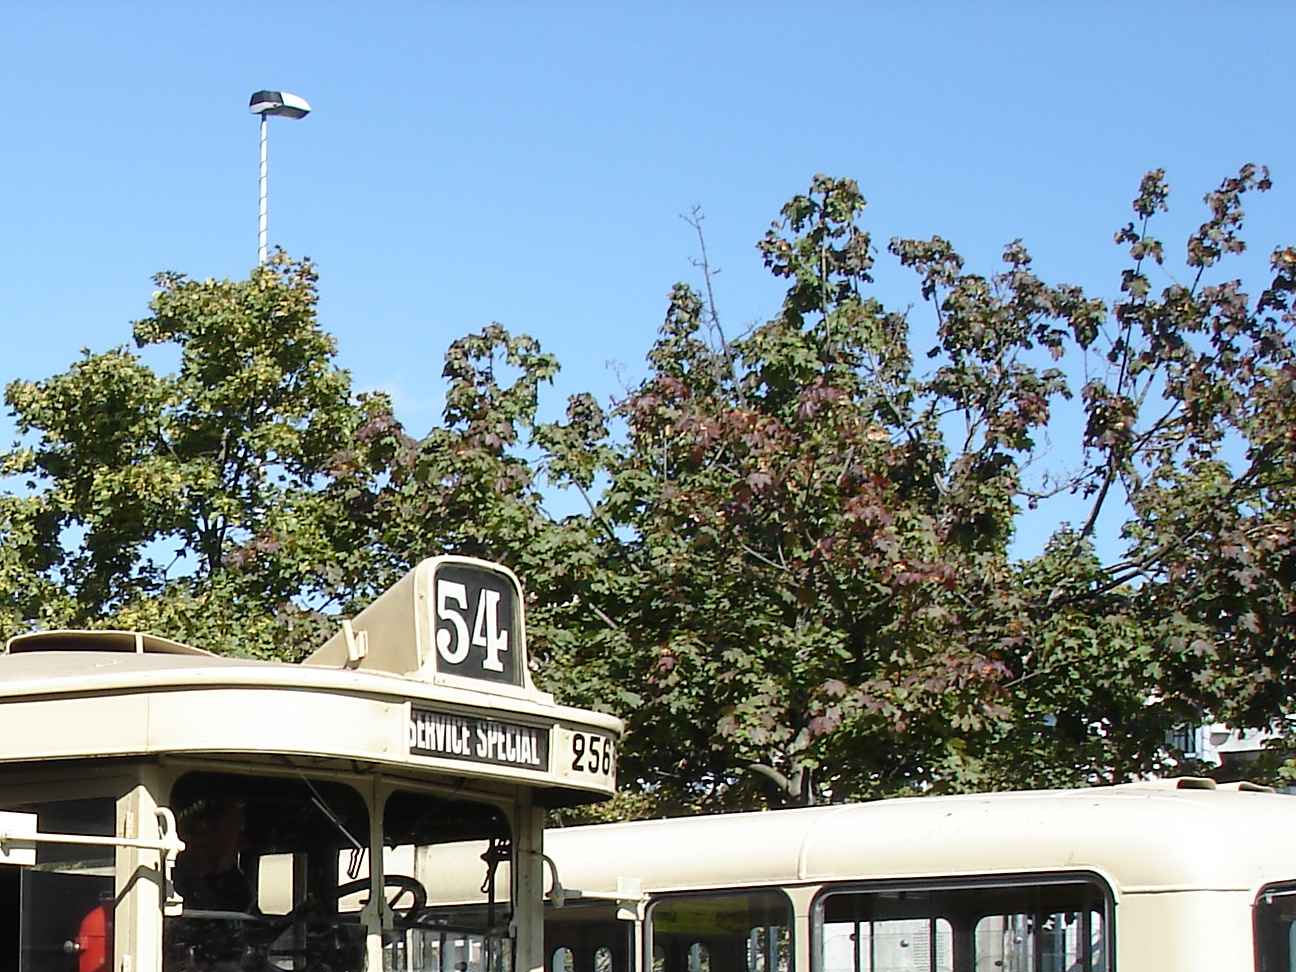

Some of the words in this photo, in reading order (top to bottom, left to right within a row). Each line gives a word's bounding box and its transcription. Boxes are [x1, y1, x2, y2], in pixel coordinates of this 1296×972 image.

[436, 579, 508, 672] 54
[476, 720, 540, 766] SPECIAL
[572, 733, 615, 777] 256
